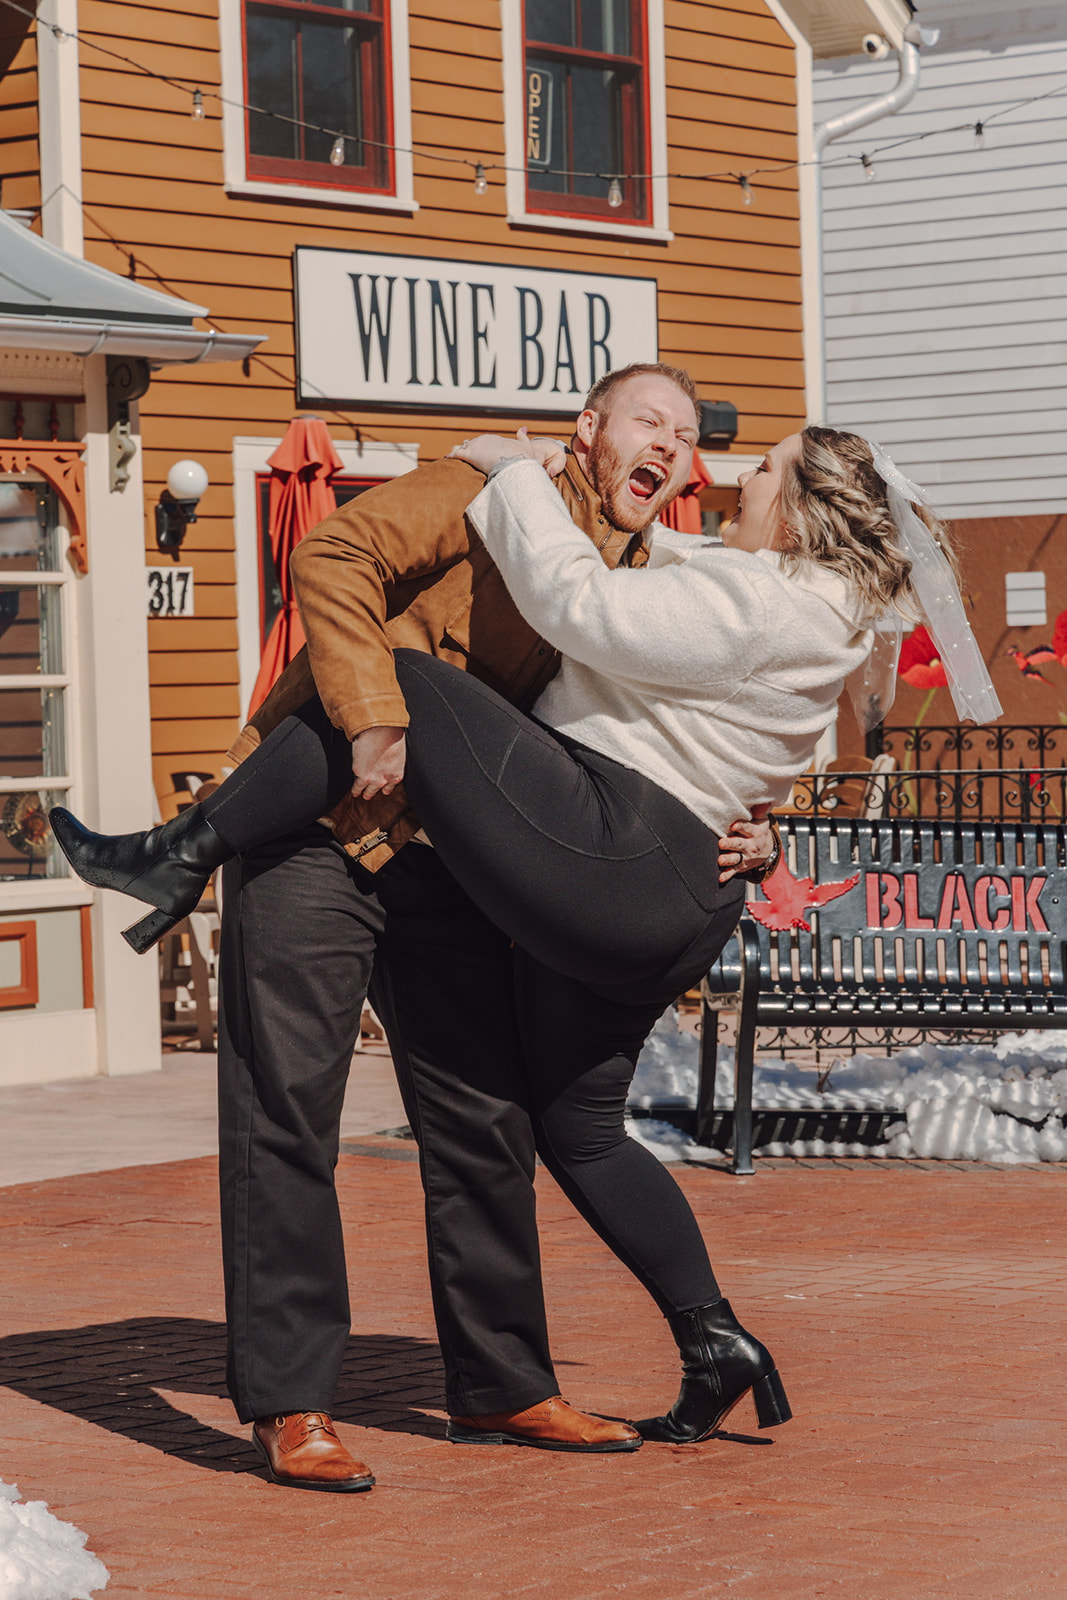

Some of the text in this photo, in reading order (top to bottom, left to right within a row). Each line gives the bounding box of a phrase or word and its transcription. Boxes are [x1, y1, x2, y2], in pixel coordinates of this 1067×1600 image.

[527, 73, 542, 160] OPEN
[347, 272, 611, 394] WINE BAR
[148, 571, 190, 613] 317
[865, 872, 1051, 932] BLACK
